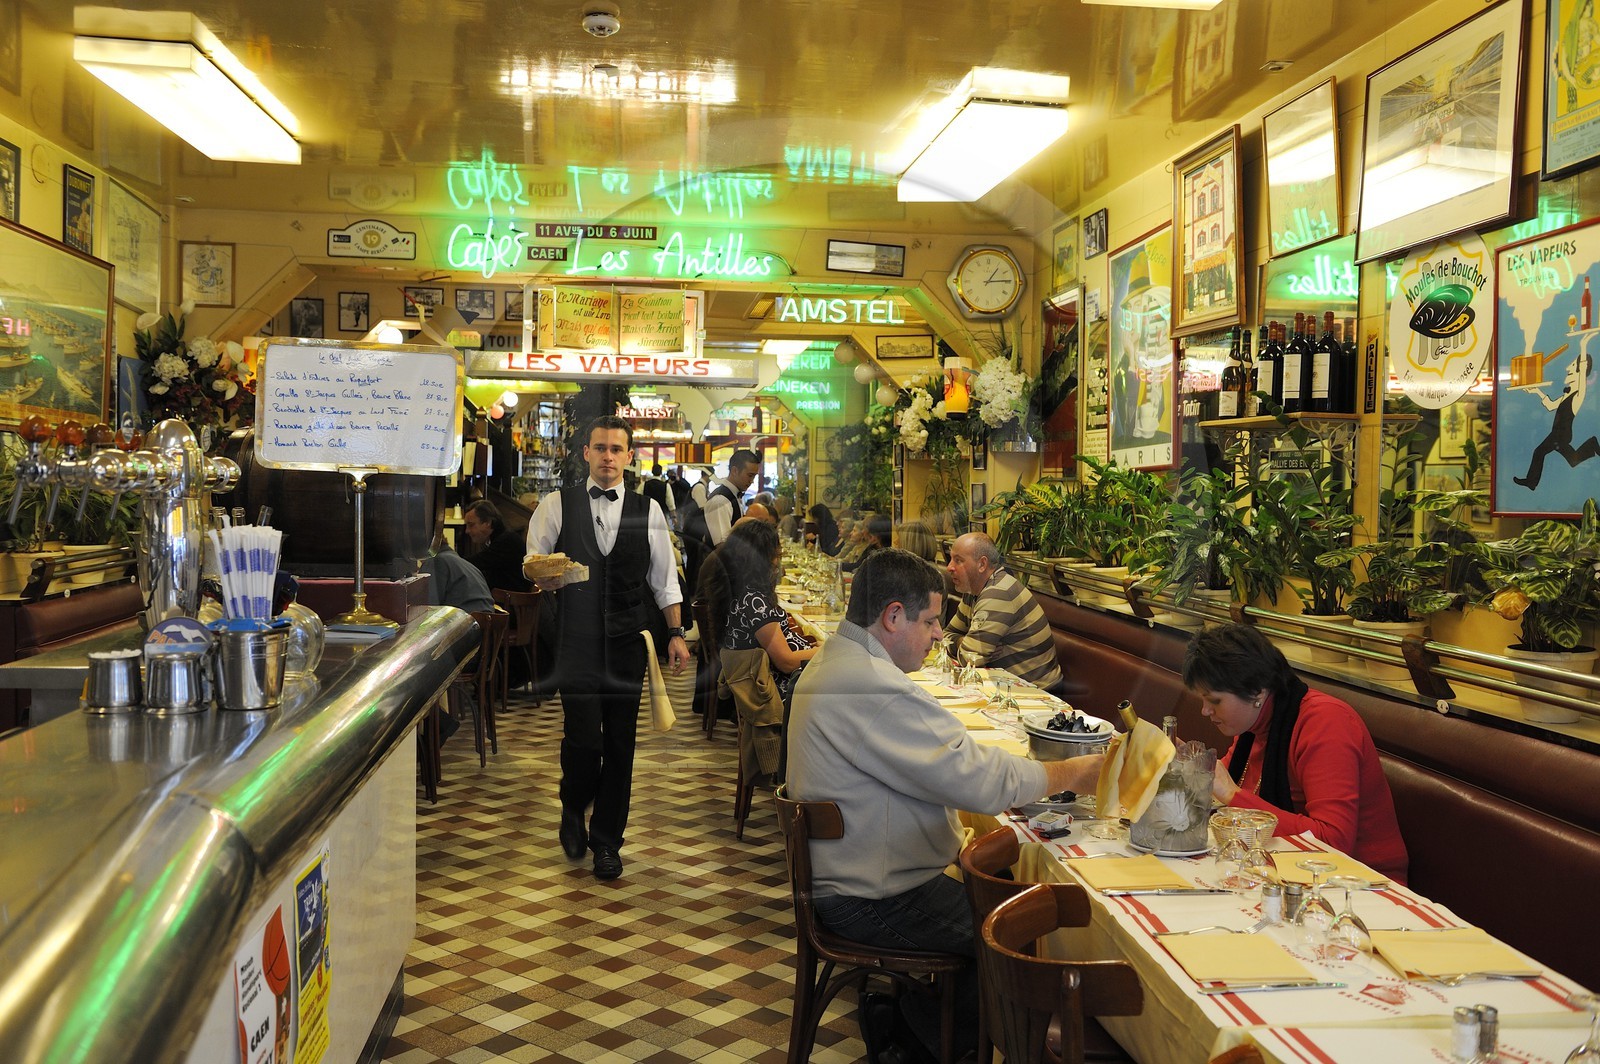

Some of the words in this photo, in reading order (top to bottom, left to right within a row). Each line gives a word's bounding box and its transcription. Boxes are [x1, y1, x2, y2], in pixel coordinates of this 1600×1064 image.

[365, 234, 379, 245] 19
[539, 224, 550, 236] 11
[587, 226, 603, 237] DU
[609, 227, 618, 238] 6
[623, 228, 653, 239] JUIN
[447, 217, 529, 279] Cafés
[530, 247, 565, 260] CAEN
[565, 228, 630, 276] Les
[653, 231, 773, 278] Antilles
[1530, 239, 1577, 265] VAPEURS
[1405, 269, 1436, 308] Moules
[1438, 259, 1449, 278] de
[1451, 257, 1488, 291] Bouchot
[567, 292, 609, 309] Mariage
[779, 297, 905, 324] AMSTEL
[275, 370, 298, 381] Salade
[507, 352, 562, 372] LES
[579, 355, 710, 376] VAPEURS
[1366, 343, 1375, 408] PAILLETTE
[796, 400, 841, 410] PRESSION
[250, 1015, 270, 1053] CAEN
